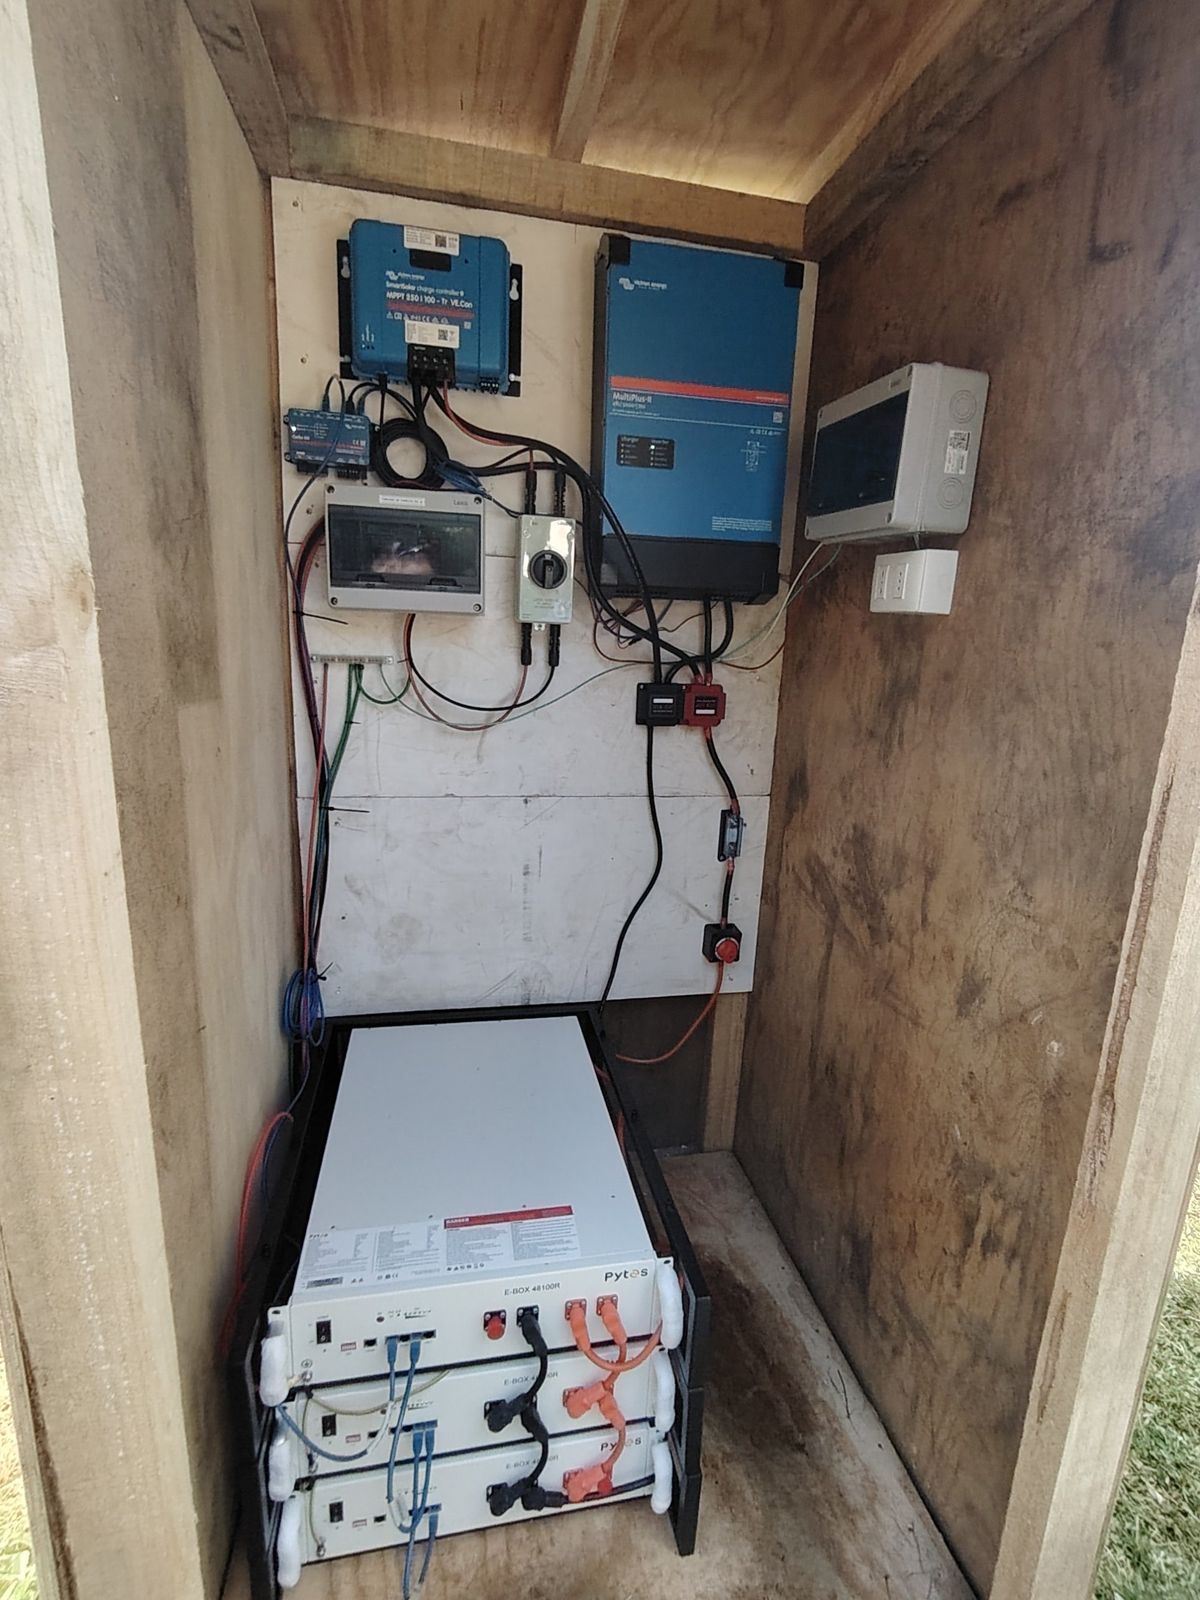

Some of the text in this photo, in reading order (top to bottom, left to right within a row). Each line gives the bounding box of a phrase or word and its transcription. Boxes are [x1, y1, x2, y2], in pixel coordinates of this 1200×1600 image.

[386, 291, 405, 301] MPPT
[423, 295, 436, 304] 100
[504, 1282, 561, 1296] E-BOX 48100R
